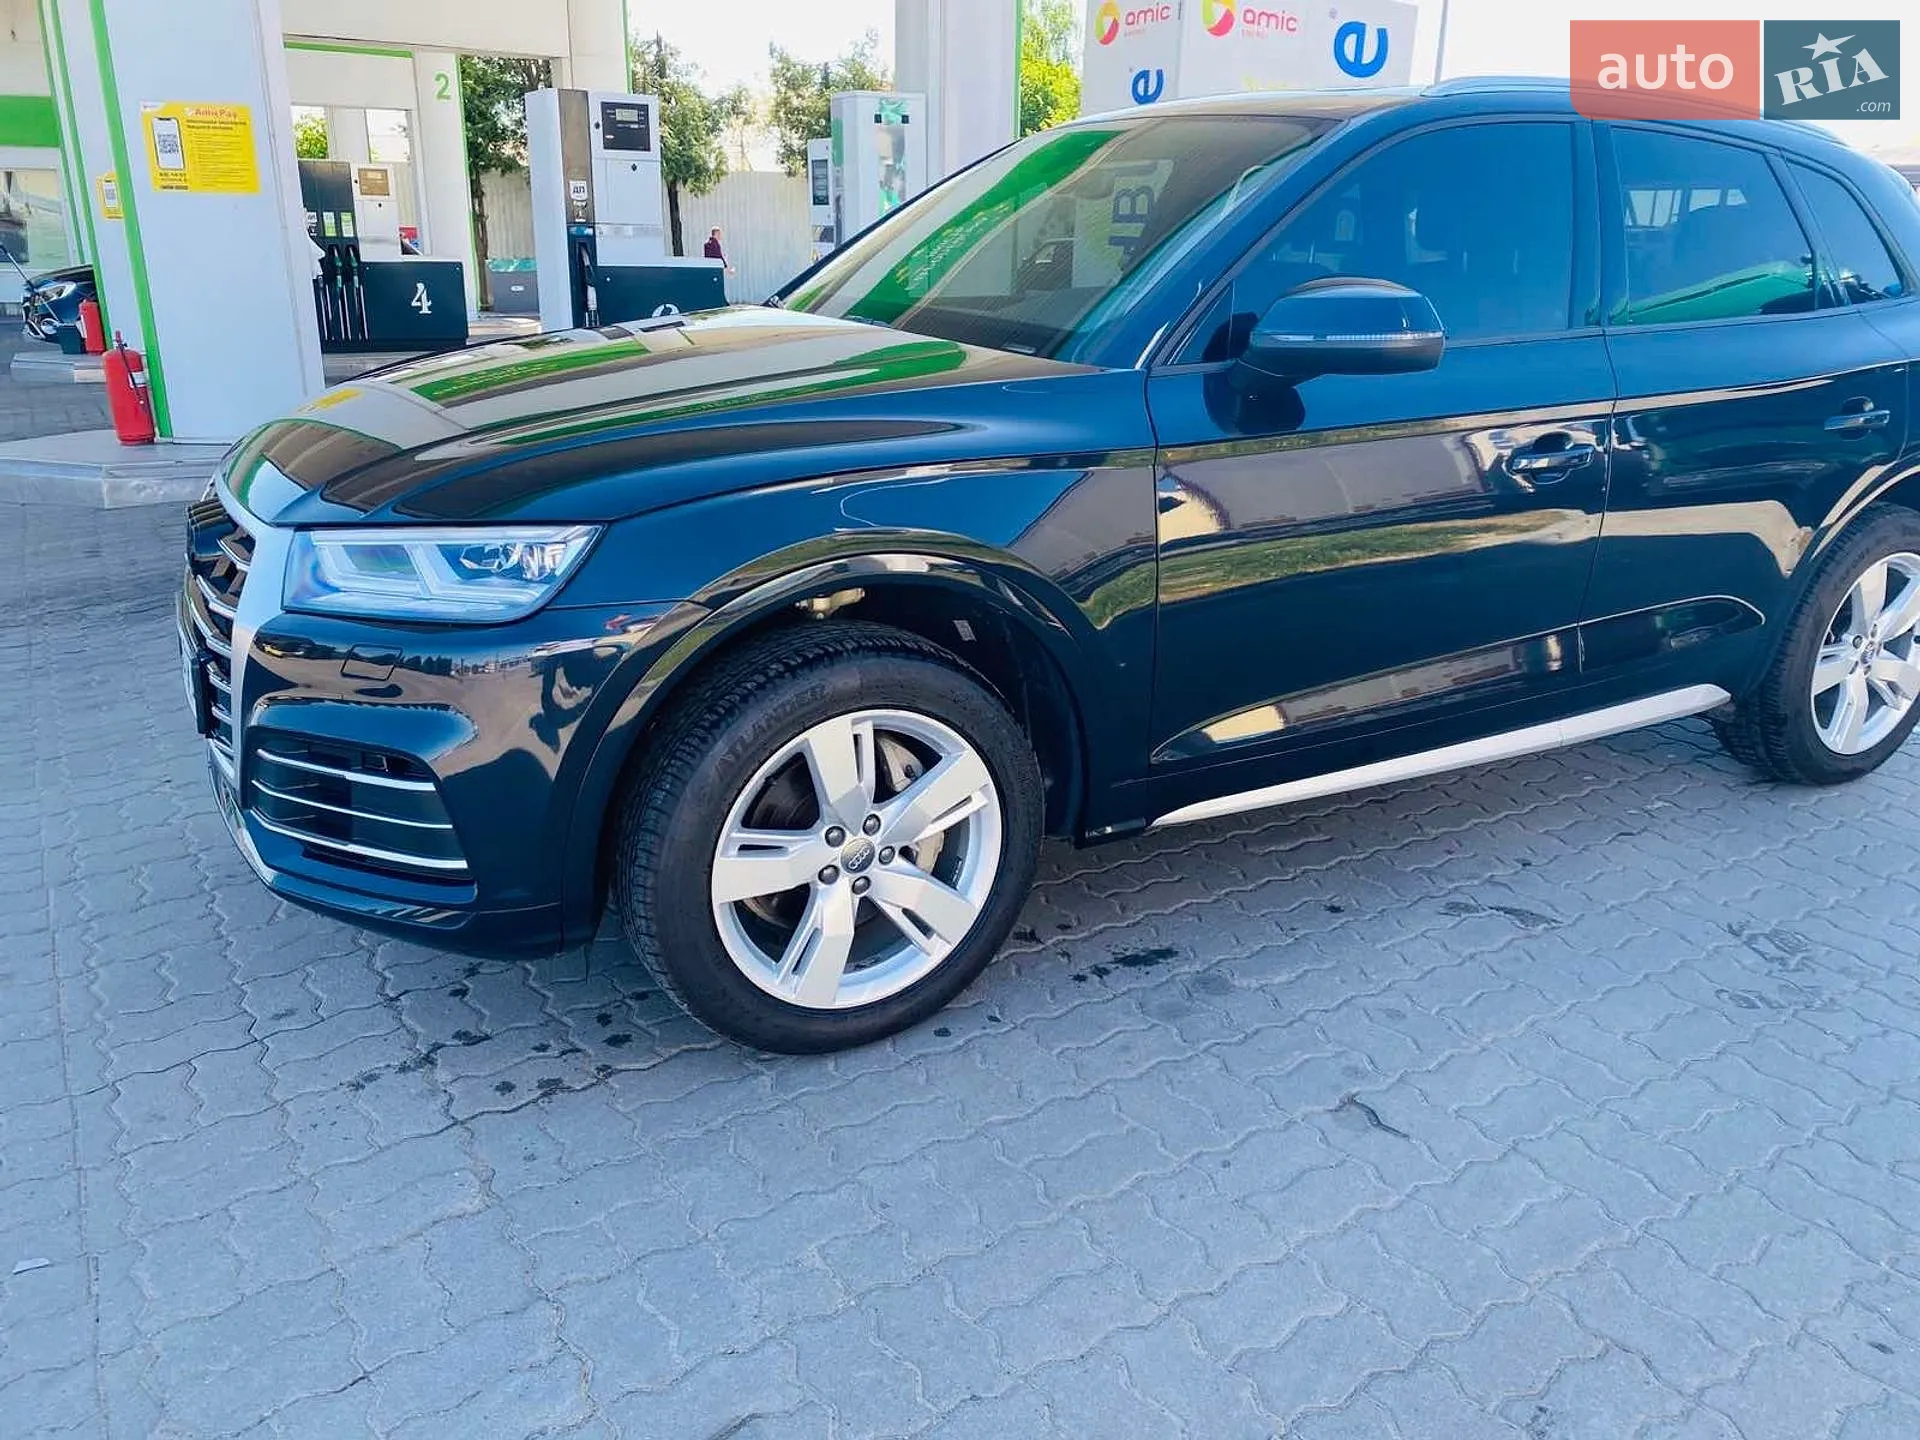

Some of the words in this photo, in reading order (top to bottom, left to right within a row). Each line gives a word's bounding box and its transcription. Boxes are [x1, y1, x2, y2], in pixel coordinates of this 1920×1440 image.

[1125, 3, 1171, 26] amic
[1243, 8, 1297, 32] amic
[434, 72, 452, 100] 2
[411, 282, 432, 315] 4
